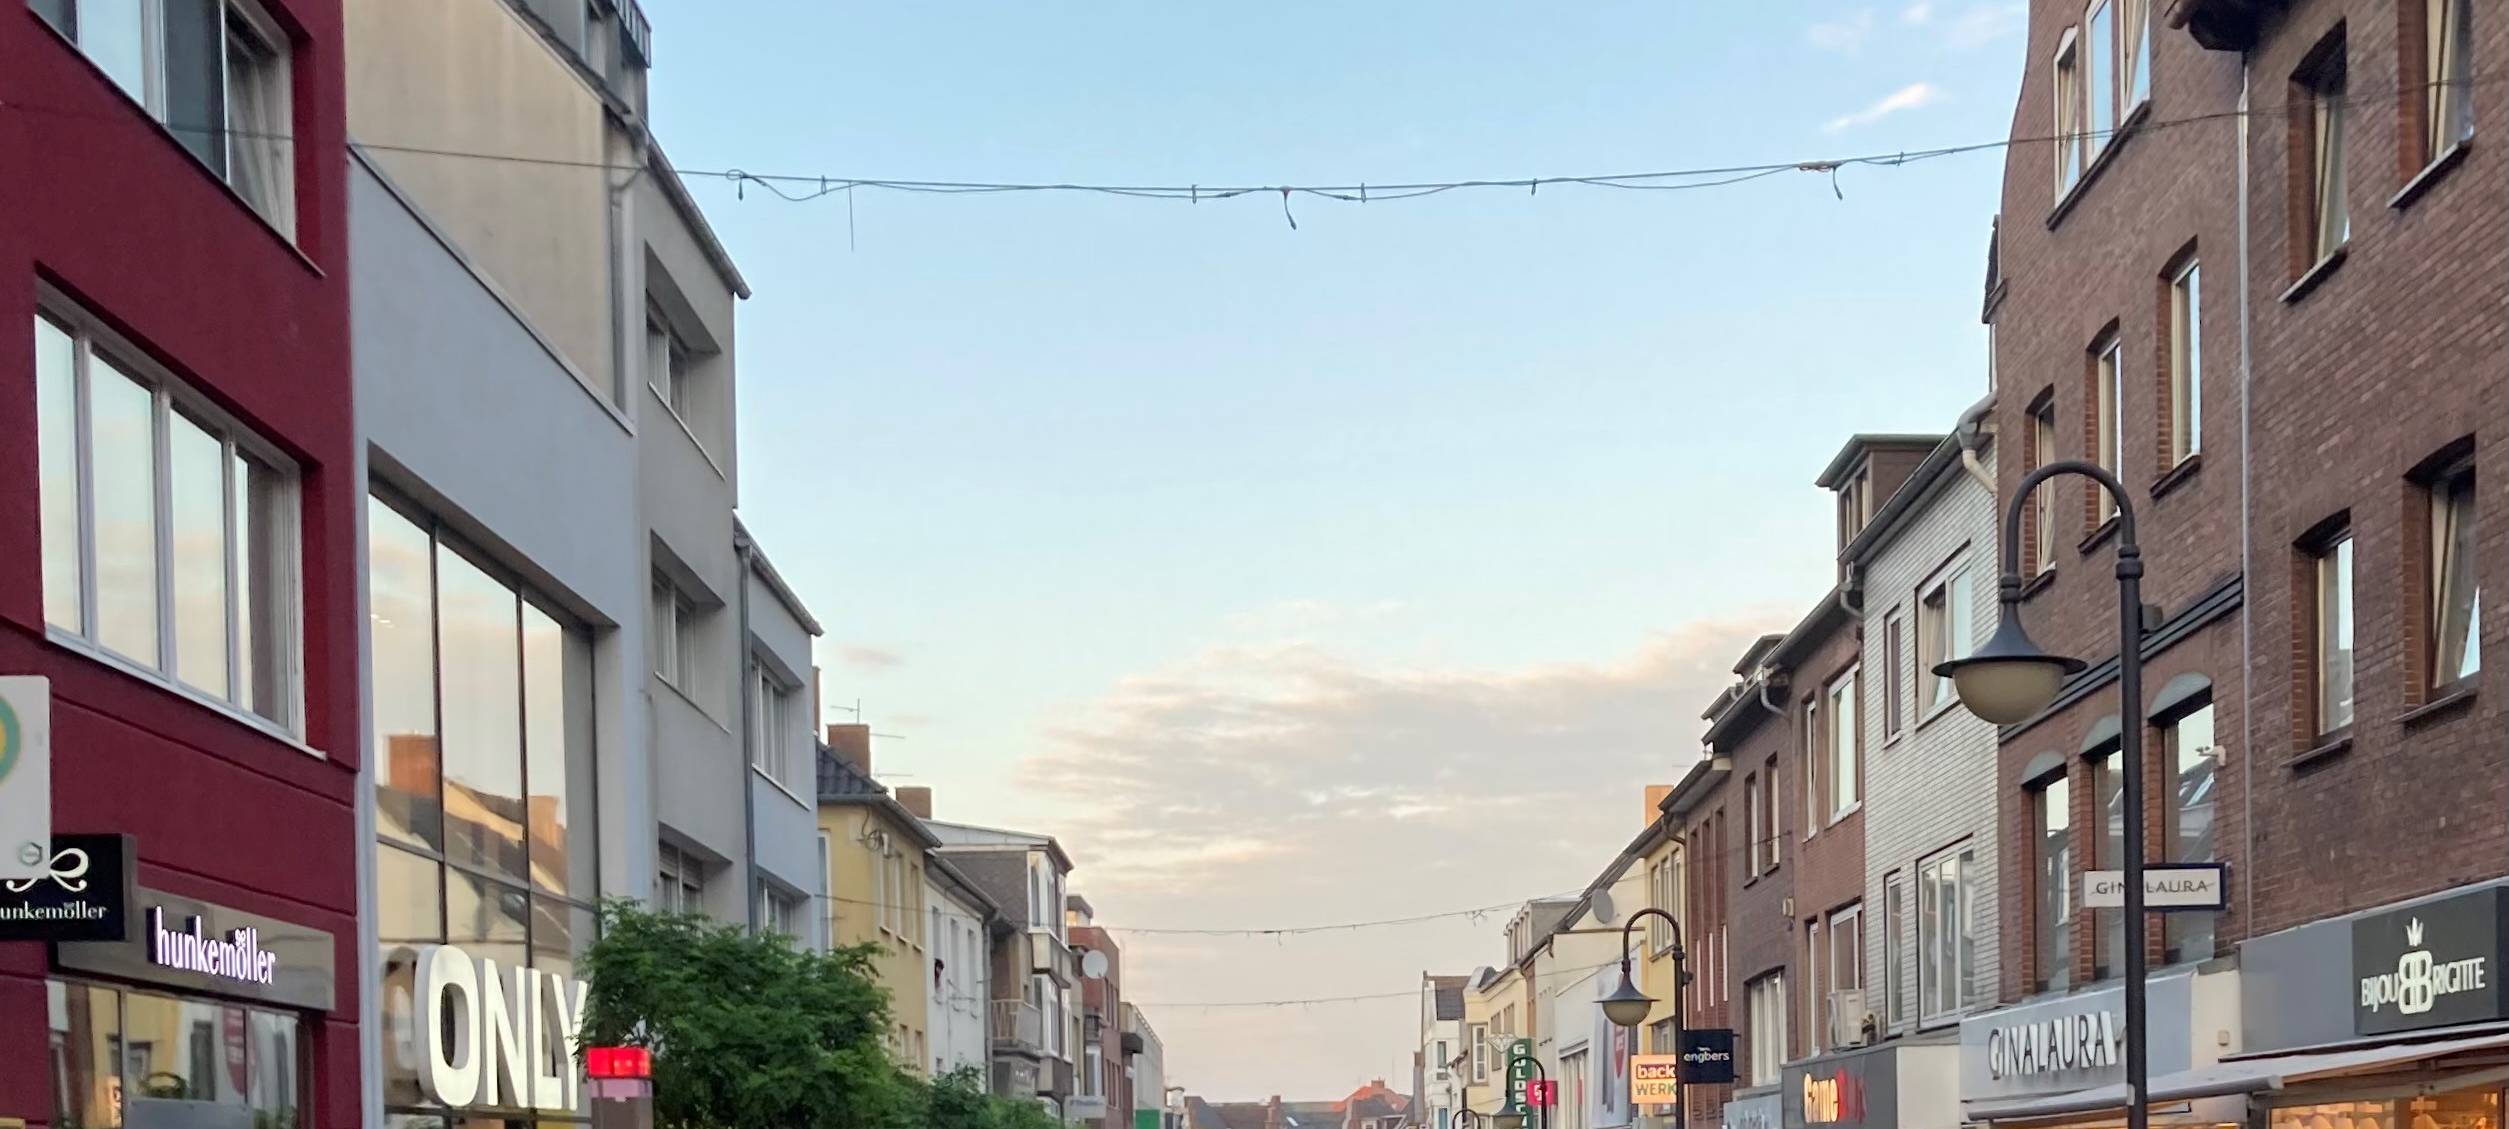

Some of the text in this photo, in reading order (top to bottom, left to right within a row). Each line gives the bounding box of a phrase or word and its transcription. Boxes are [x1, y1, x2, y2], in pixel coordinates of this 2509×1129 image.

[2096, 880, 2208, 895] GINLAURA
[156, 905, 276, 985] hunkemöller
[418, 944, 588, 1111] ONLY
[1988, 1010, 2116, 1081] GINALAURA
[1683, 1051, 1730, 1064] engbers
[1637, 1064, 1676, 1079] back
[1635, 1082, 1677, 1096] WERK
